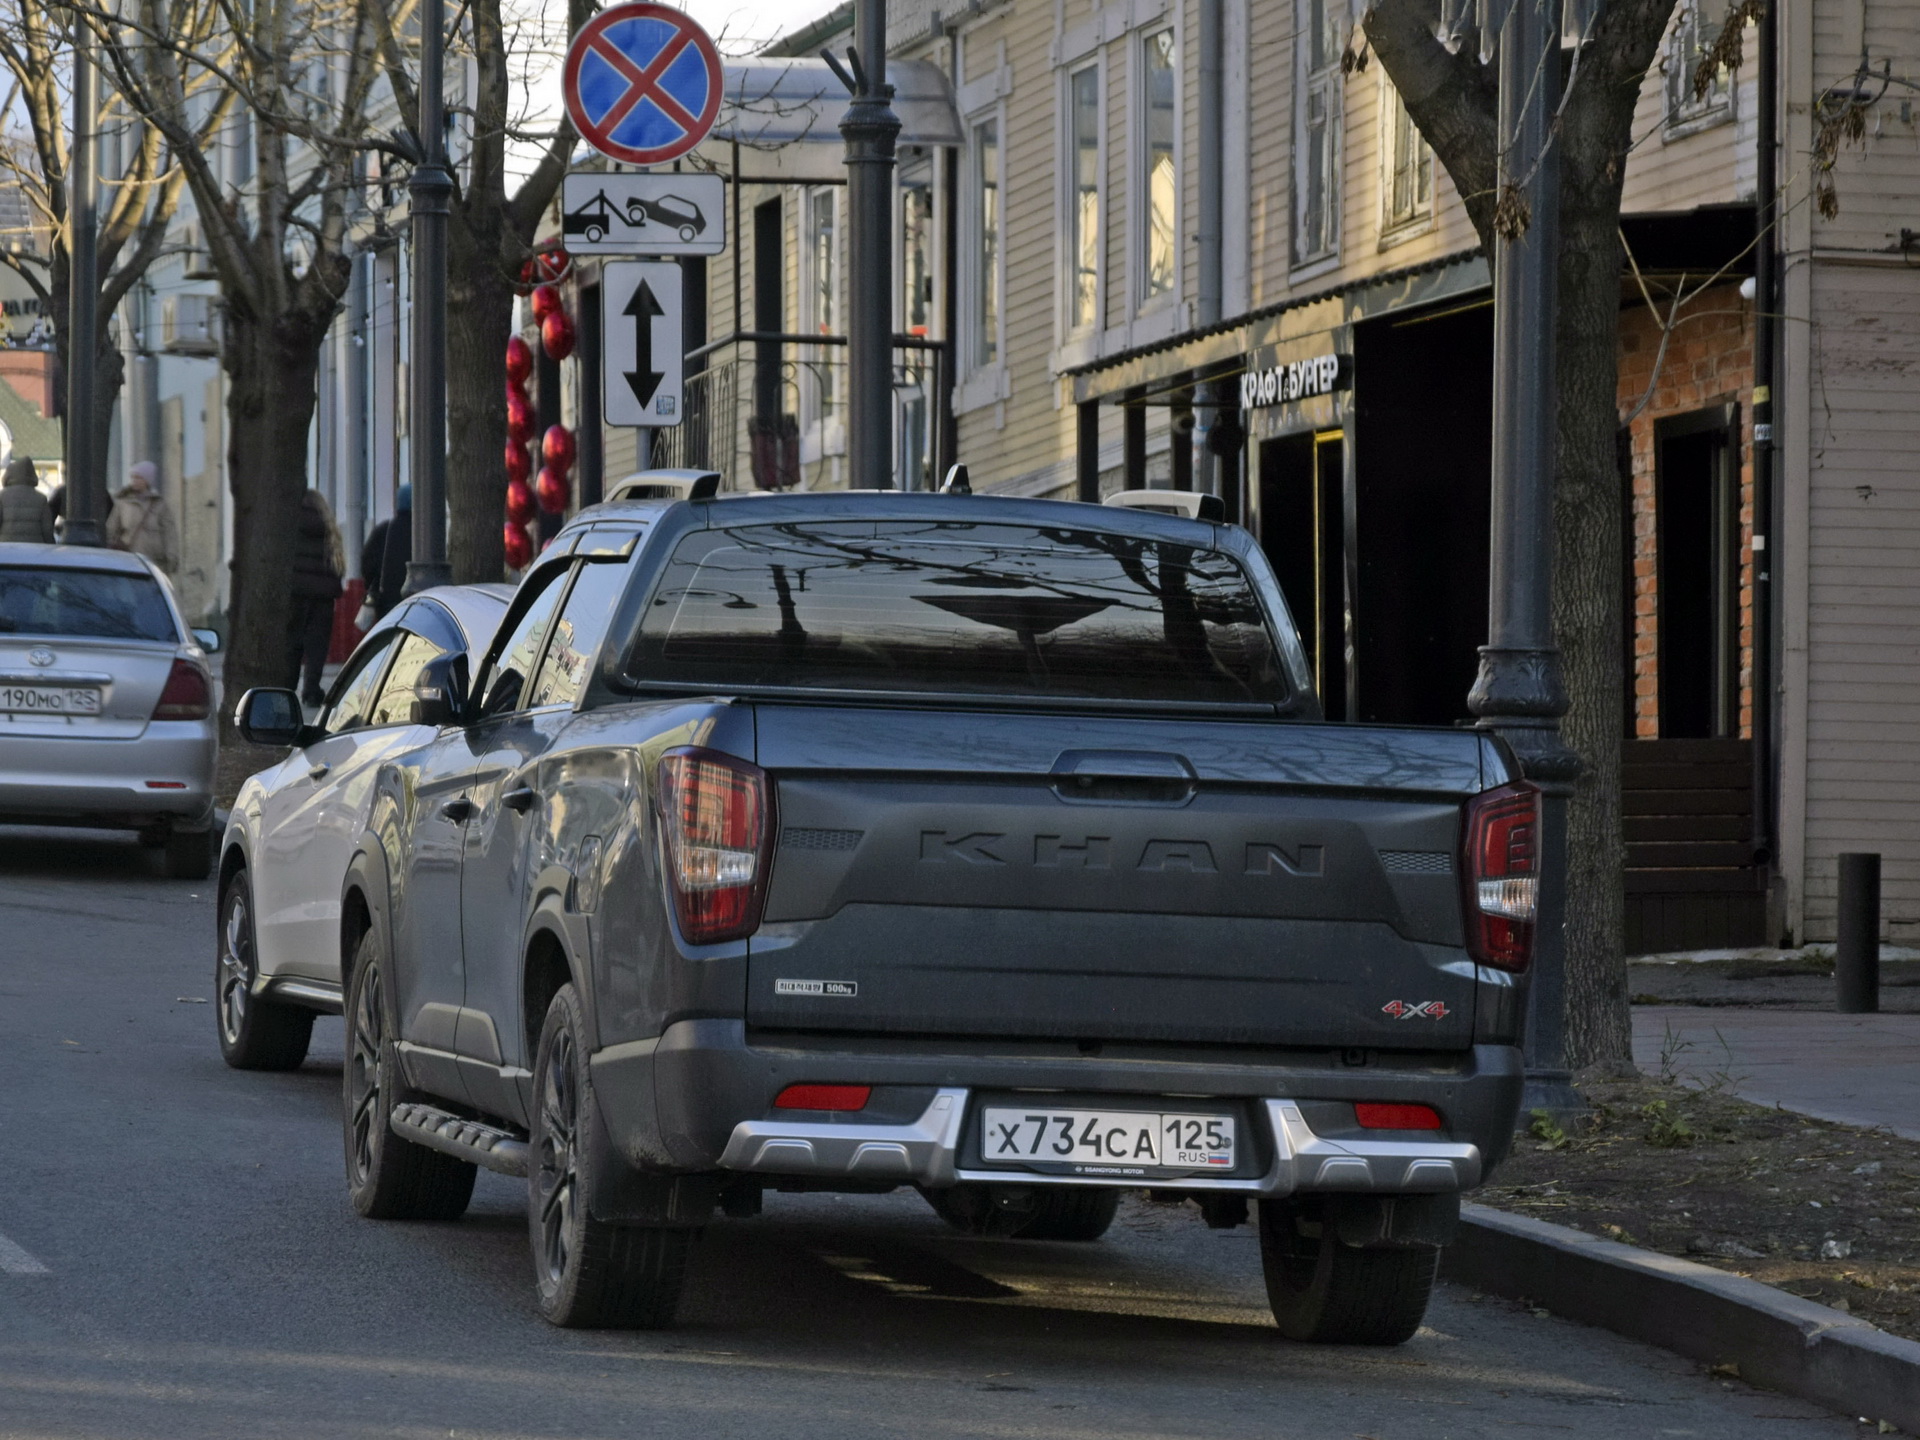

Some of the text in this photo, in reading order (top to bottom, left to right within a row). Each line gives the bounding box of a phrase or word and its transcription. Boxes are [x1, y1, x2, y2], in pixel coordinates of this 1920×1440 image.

[919, 830, 1325, 877] KHAN
[827, 984, 852, 994] 500kg
[998, 1115, 1224, 1159] Х734СА 125
[1178, 1152, 1207, 1163] RUS
